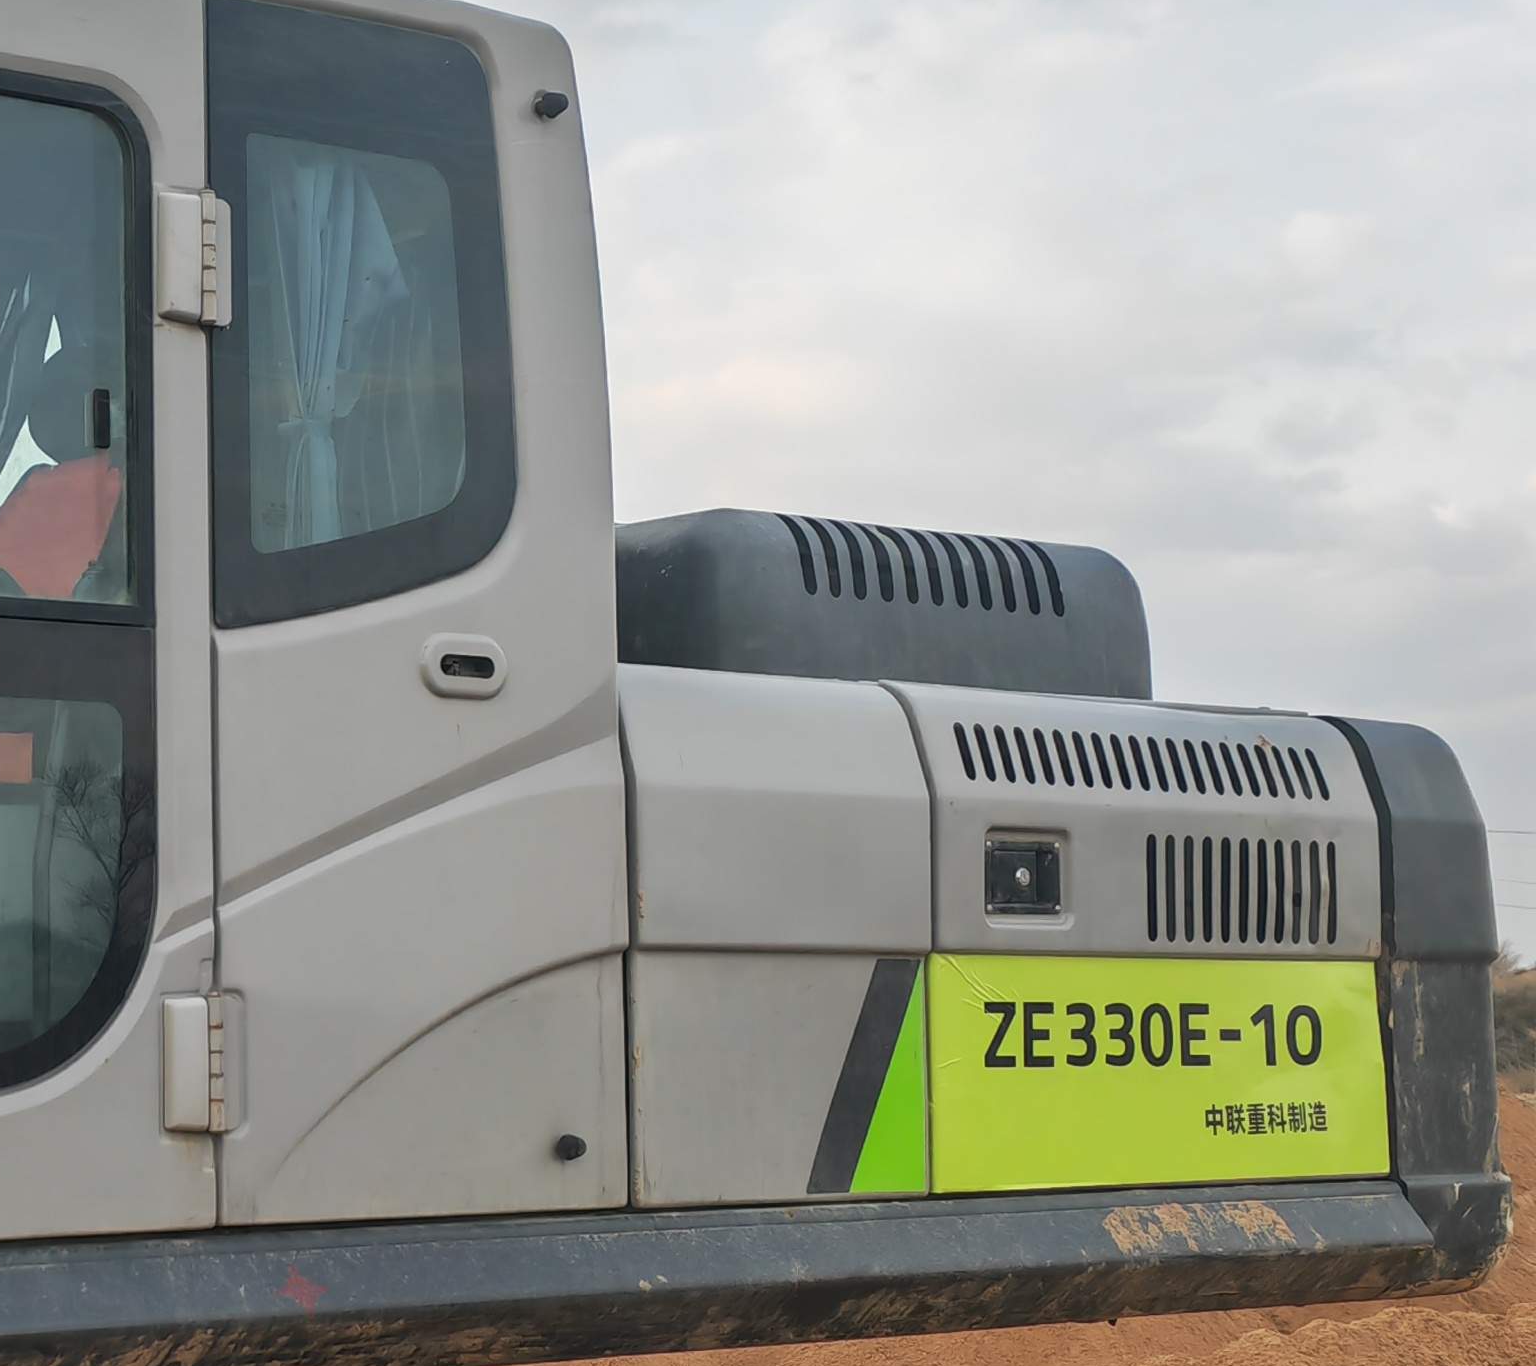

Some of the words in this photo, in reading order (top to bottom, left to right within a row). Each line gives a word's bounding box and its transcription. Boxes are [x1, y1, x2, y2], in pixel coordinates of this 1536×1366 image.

[983, 1001, 1323, 1068] ZE330E-10
[1204, 1101, 1329, 1136] 中联重科制造
